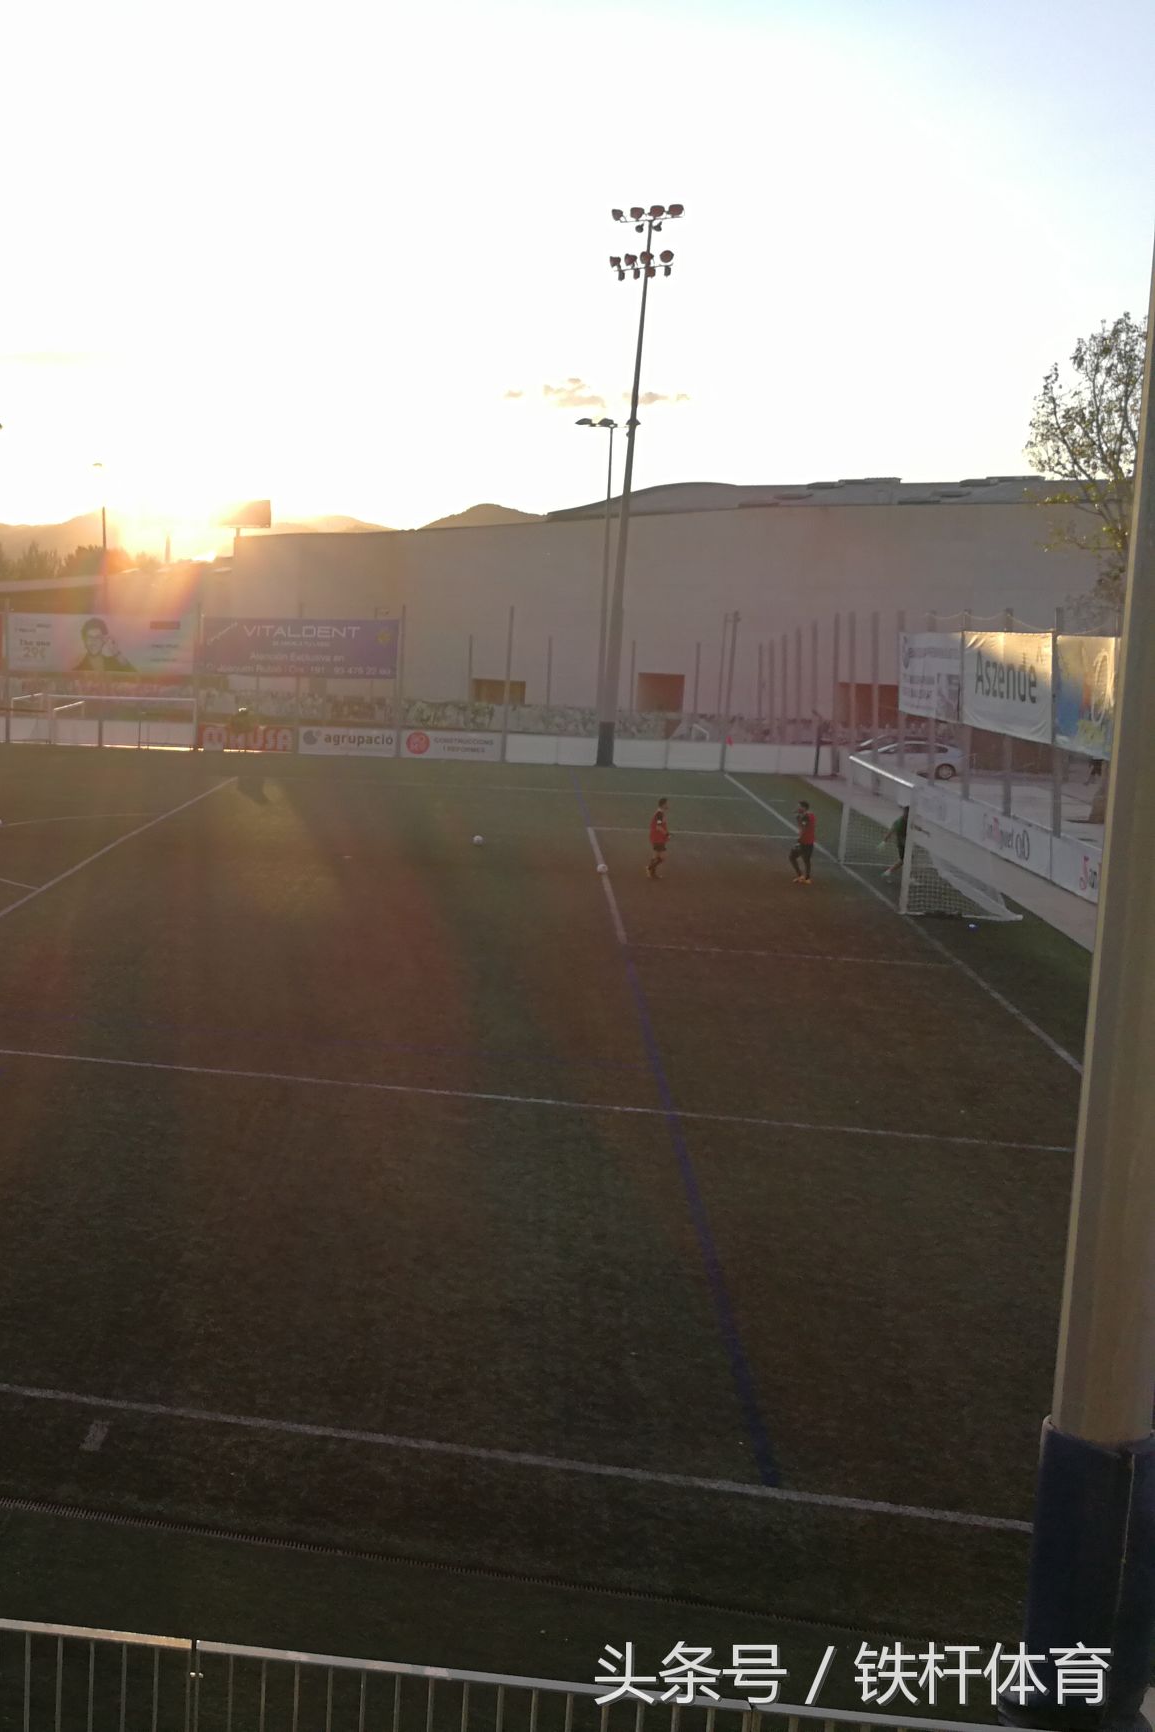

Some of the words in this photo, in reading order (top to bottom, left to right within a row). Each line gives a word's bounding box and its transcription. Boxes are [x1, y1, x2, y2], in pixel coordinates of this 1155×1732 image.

[243, 625, 360, 639] VITALDENT
[975, 650, 1037, 703] Aszende
[324, 731, 394, 746] agrupació
